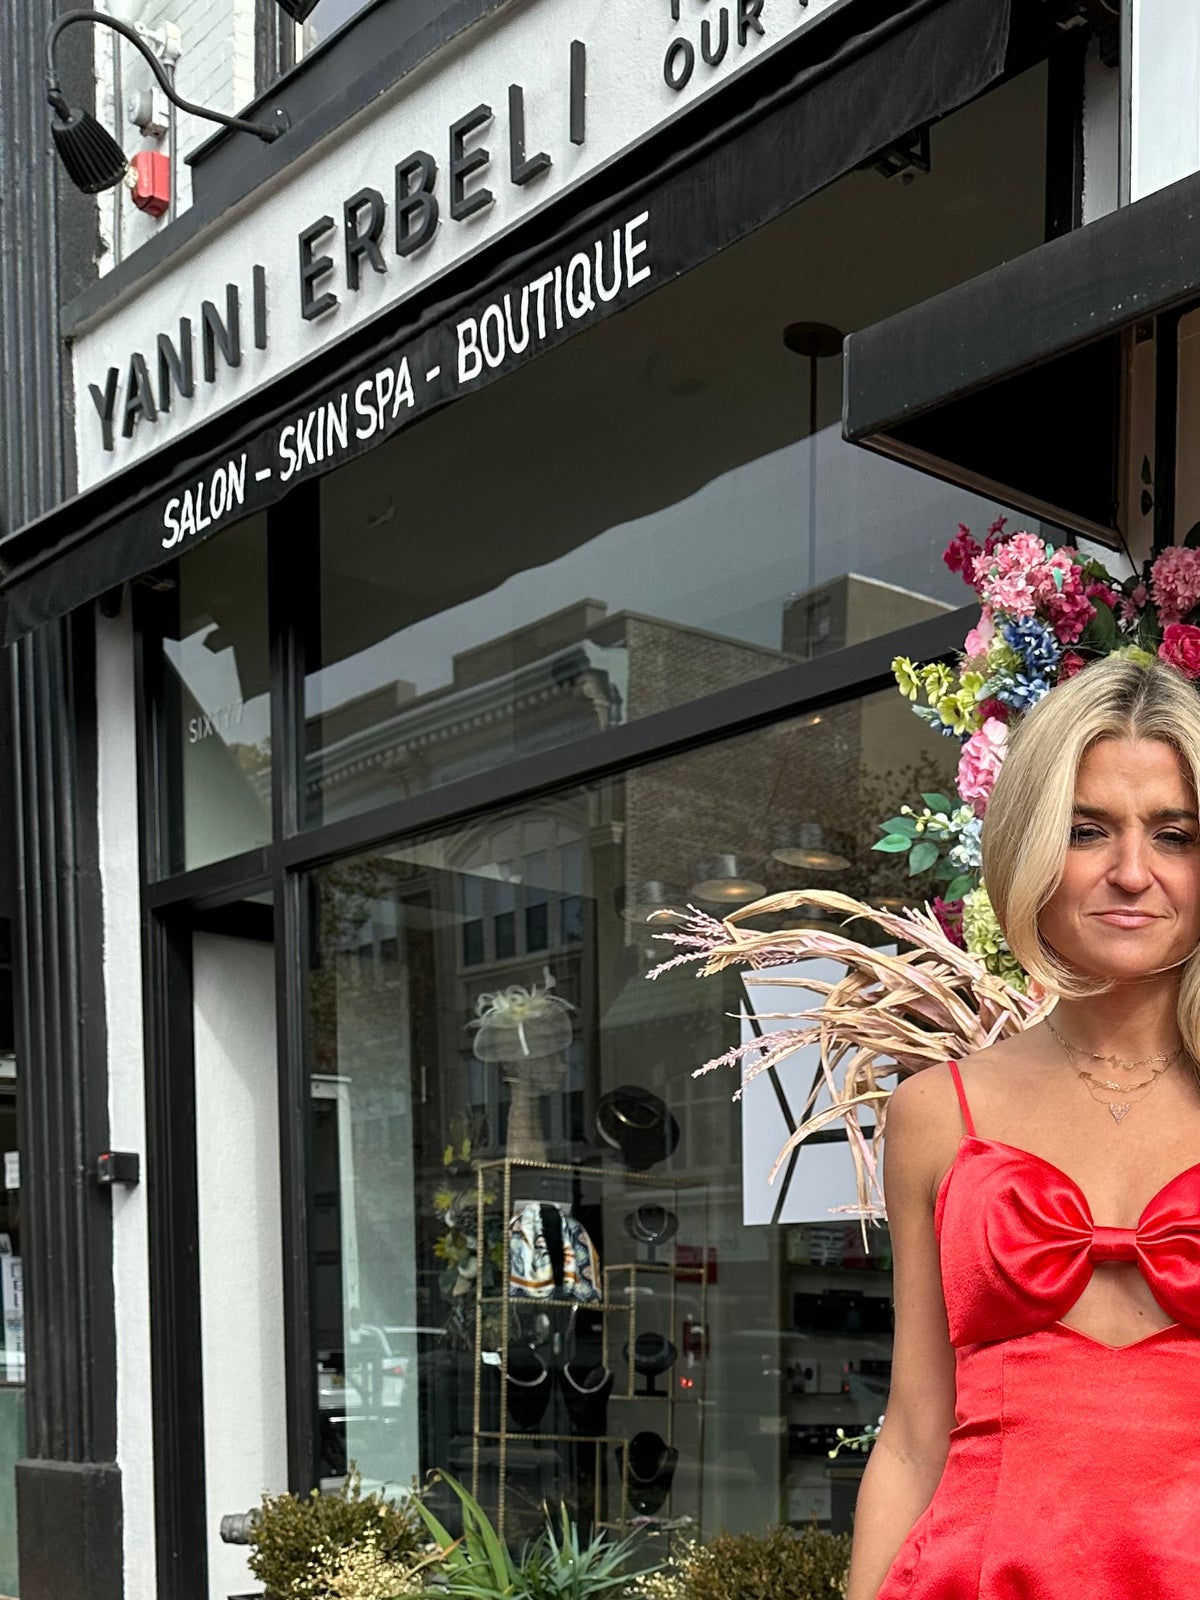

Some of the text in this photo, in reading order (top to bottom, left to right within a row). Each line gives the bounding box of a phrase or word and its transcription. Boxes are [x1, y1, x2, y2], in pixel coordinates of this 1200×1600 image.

[664, 0, 765, 90] OUR
[88, 39, 586, 451] YANNI ERBELI
[162, 453, 246, 549] SALON
[456, 211, 651, 384] BOUTIQUE
